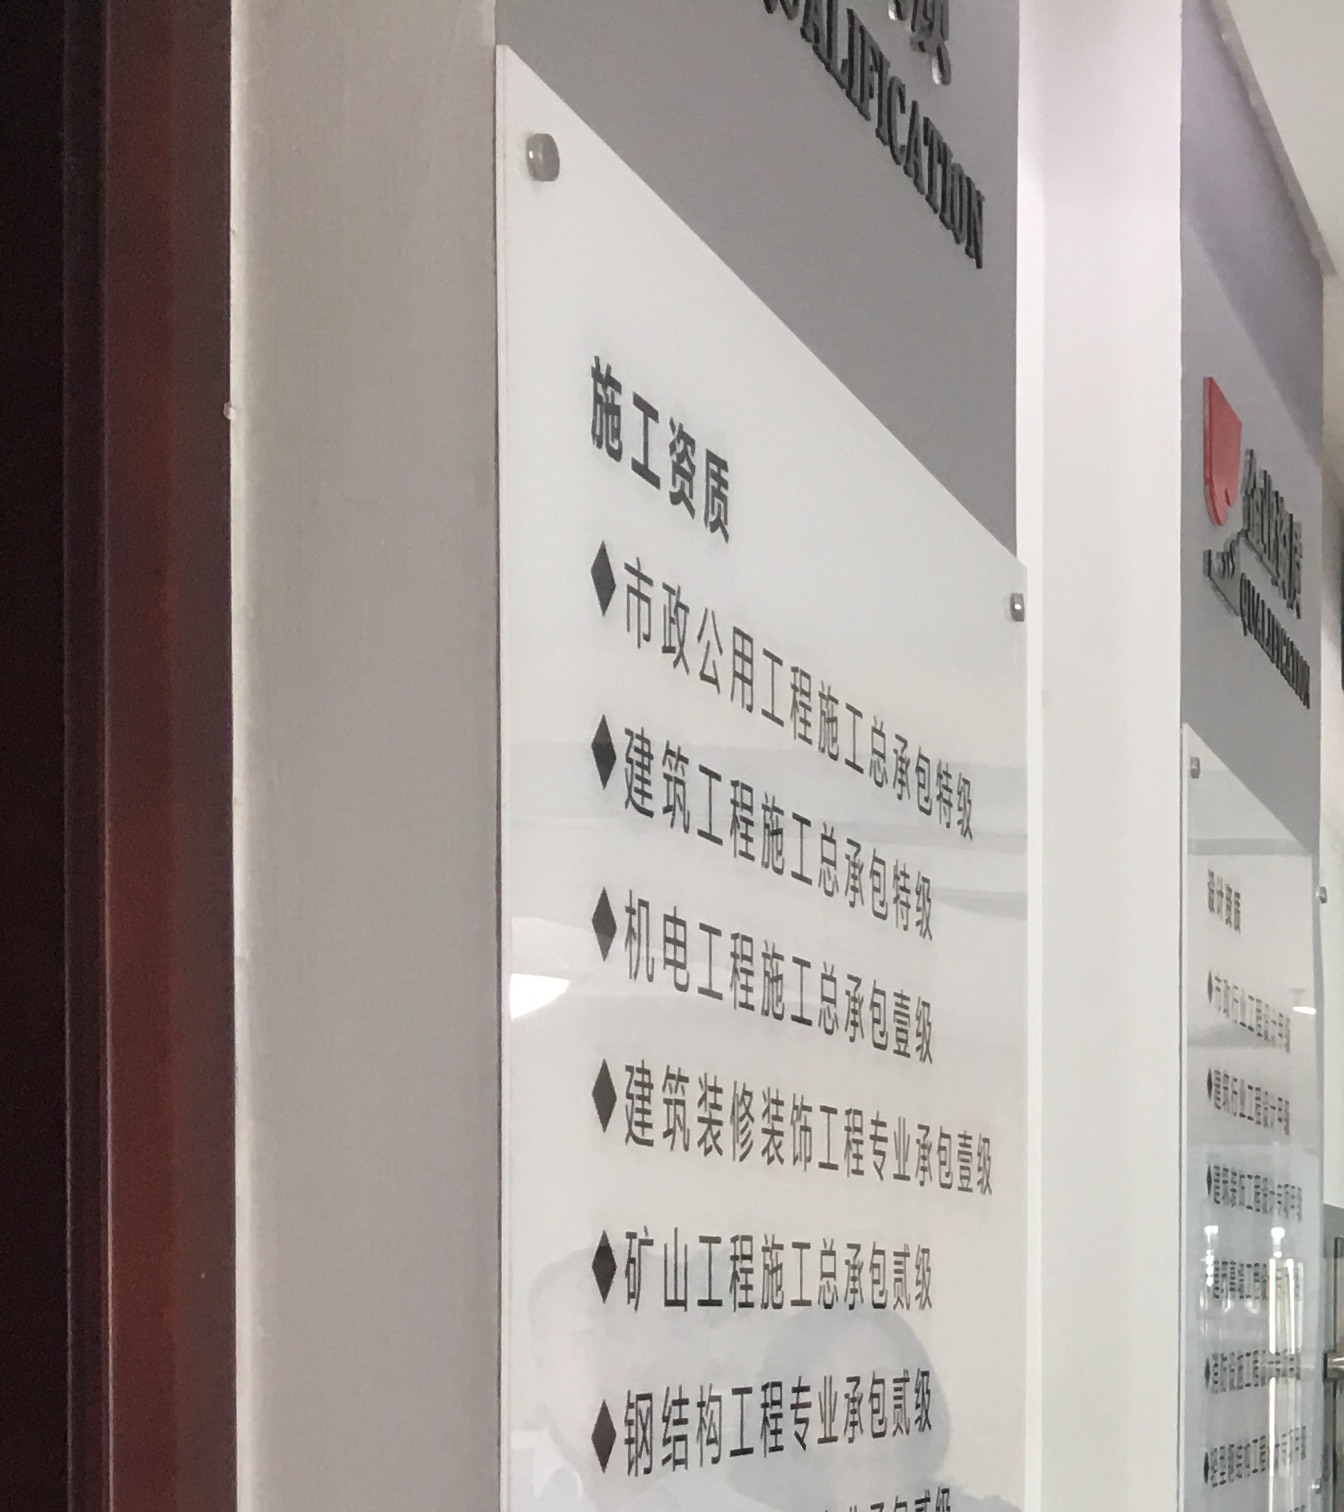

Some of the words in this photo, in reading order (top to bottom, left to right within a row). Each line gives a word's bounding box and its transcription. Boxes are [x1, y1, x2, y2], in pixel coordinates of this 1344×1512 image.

[763, 0, 985, 268] ALIFICATION
[591, 356, 730, 543] 施工资质
[624, 557, 973, 840] 市政公用工程施工总承包特级
[624, 726, 932, 940] 建筑工程施工总承包特级
[624, 889, 932, 1064] 机电工程施工总承包壹级
[624, 1059, 992, 1195] 建筑装修装饰工程专业承包壹级
[624, 1225, 932, 1312] 矿山工程施工总承包贰级
[624, 1370, 932, 1476] 钢结构工程专业承包贰级
